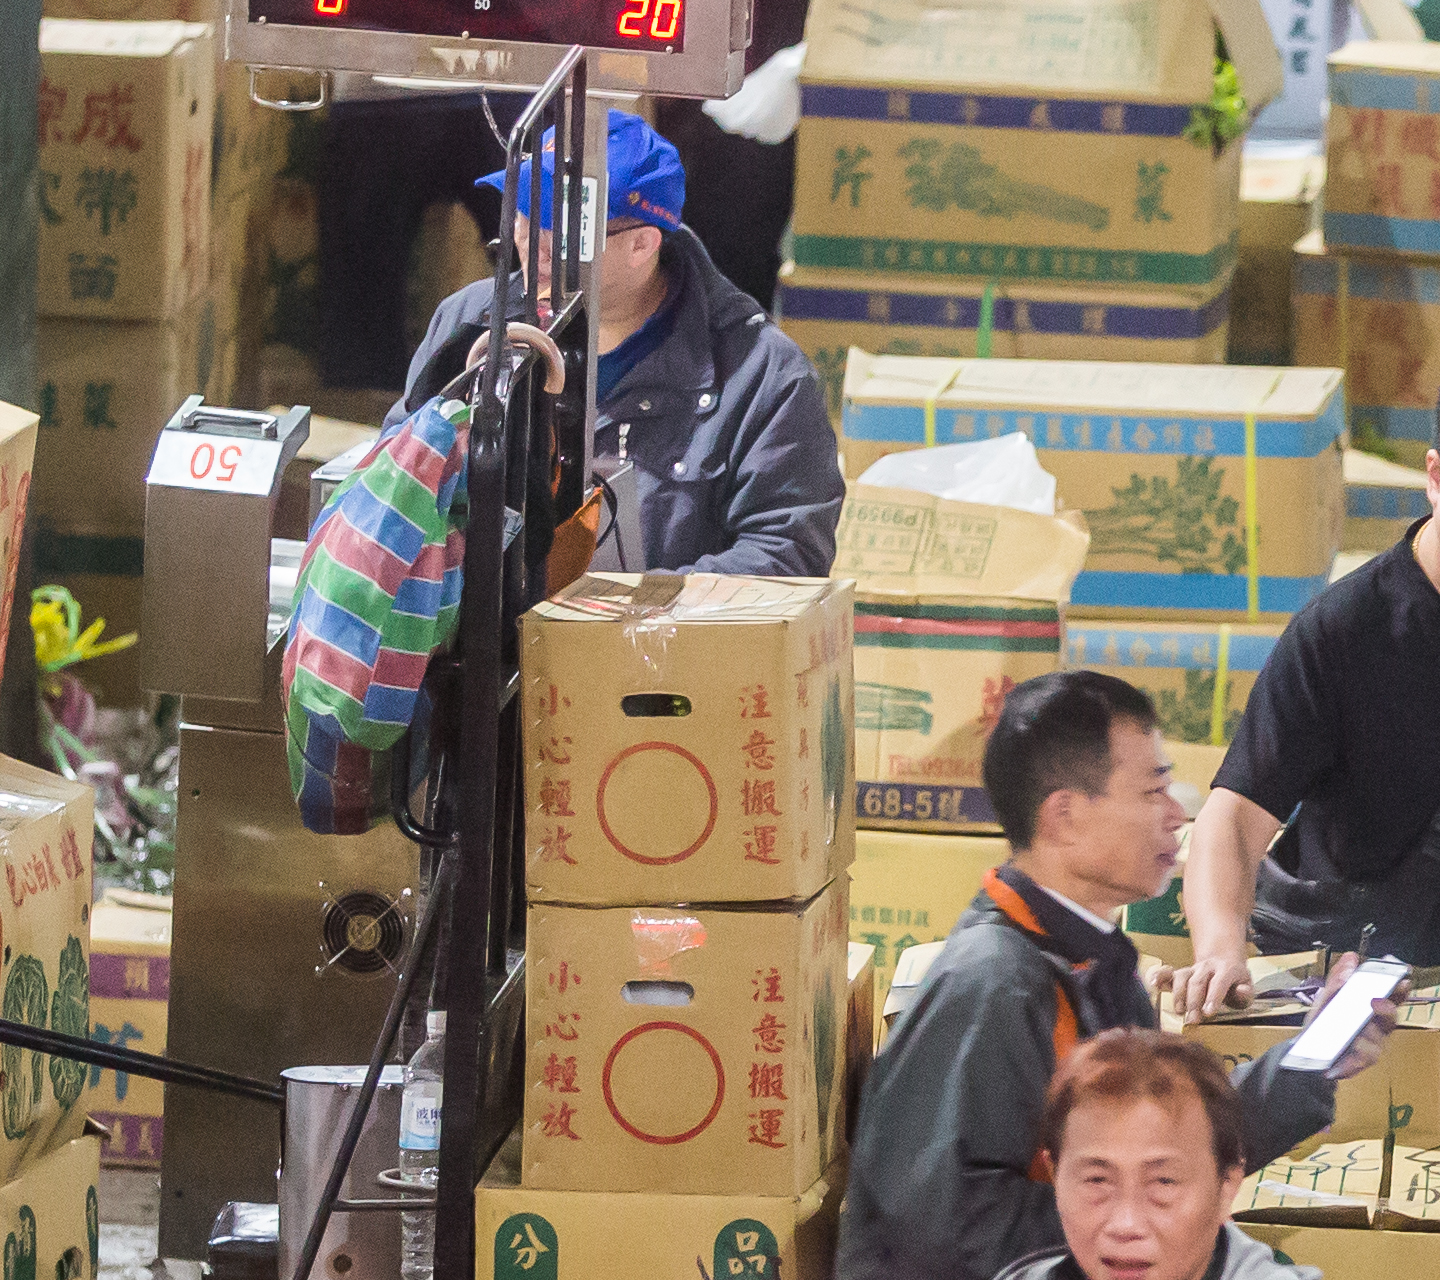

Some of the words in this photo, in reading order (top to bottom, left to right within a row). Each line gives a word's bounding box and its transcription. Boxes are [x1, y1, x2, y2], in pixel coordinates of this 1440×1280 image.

[190, 442, 243, 482] 50
[538, 684, 578, 867] 小心輕放
[738, 684, 783, 867] 注意搬運
[541, 961, 583, 1142] 小心輕放
[747, 967, 789, 1150] 注意搬運
